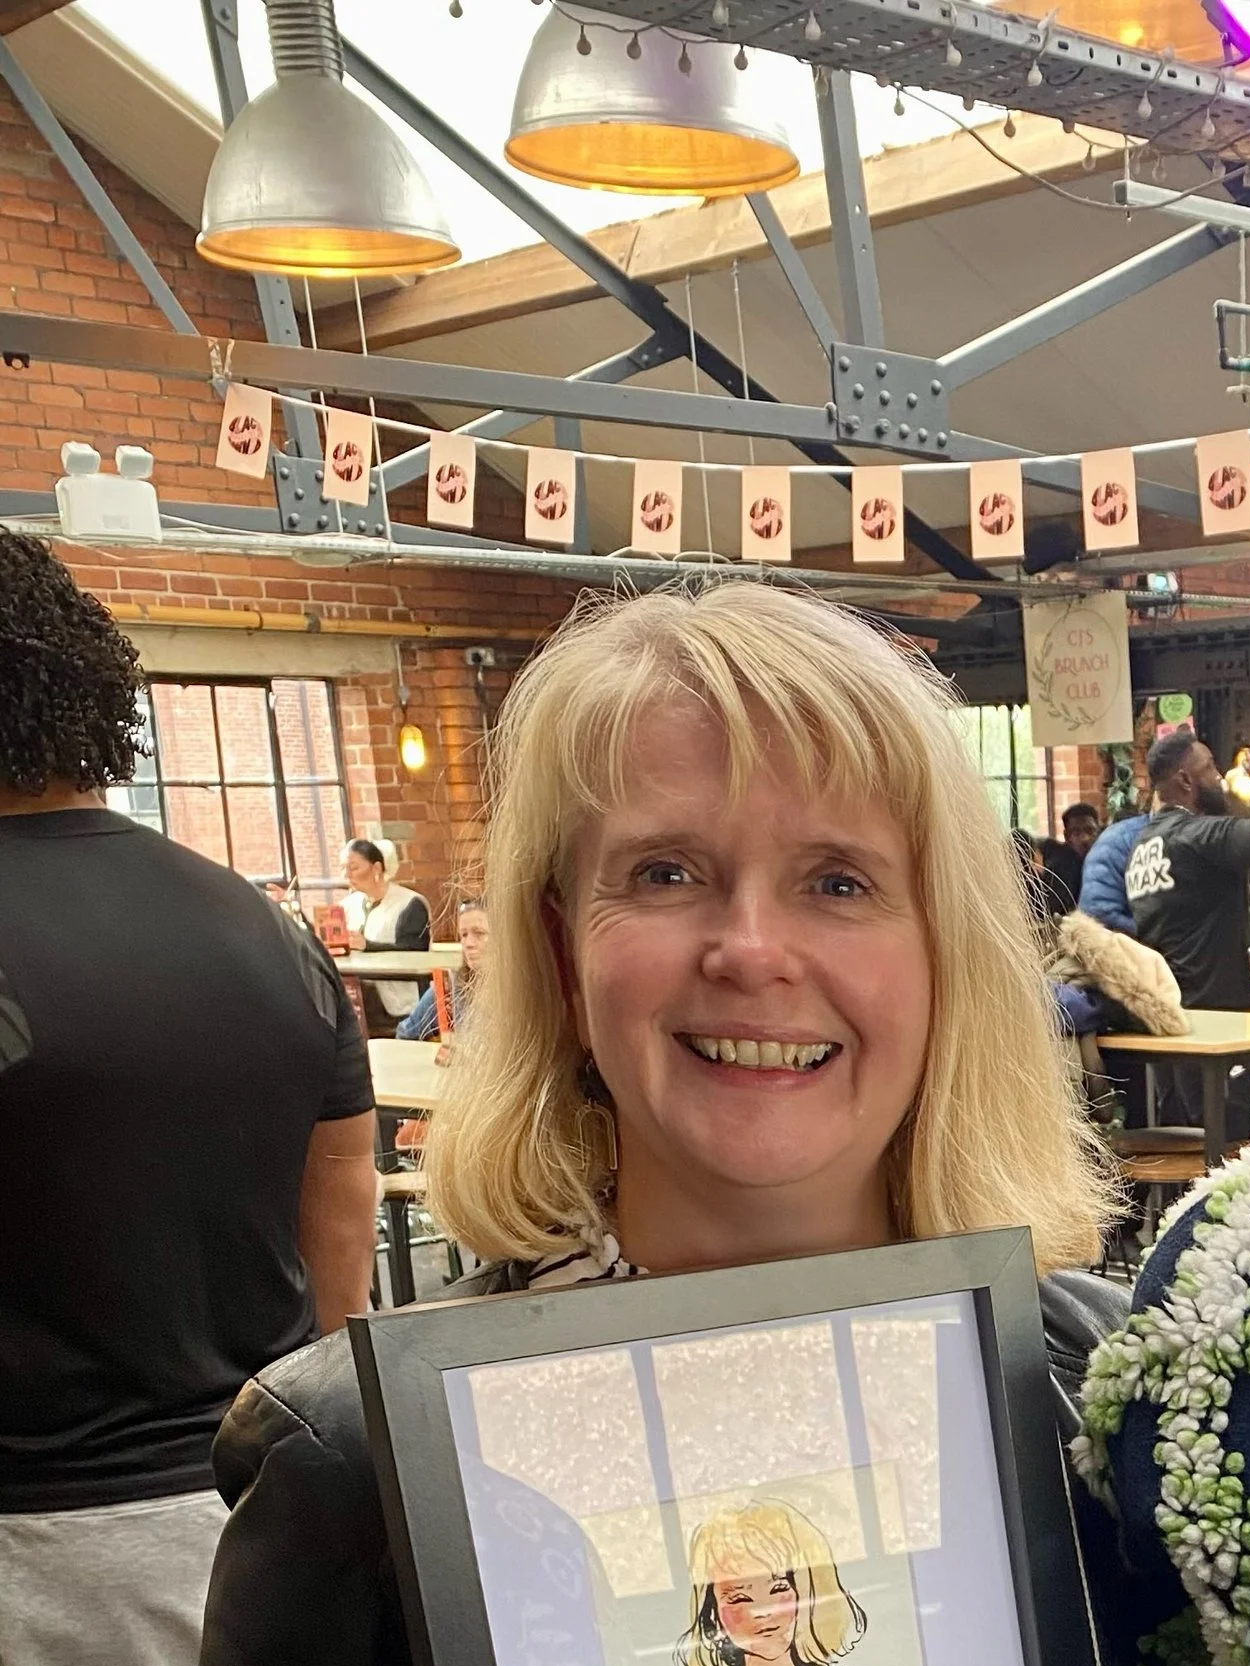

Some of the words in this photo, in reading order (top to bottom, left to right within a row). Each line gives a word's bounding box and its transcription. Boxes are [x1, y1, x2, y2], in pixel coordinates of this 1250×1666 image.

[1054, 654, 1110, 676] BRUNCH
[1067, 682, 1100, 699] CLUB
[1132, 841, 1161, 868] AIR
[1127, 862, 1170, 893] MAX
